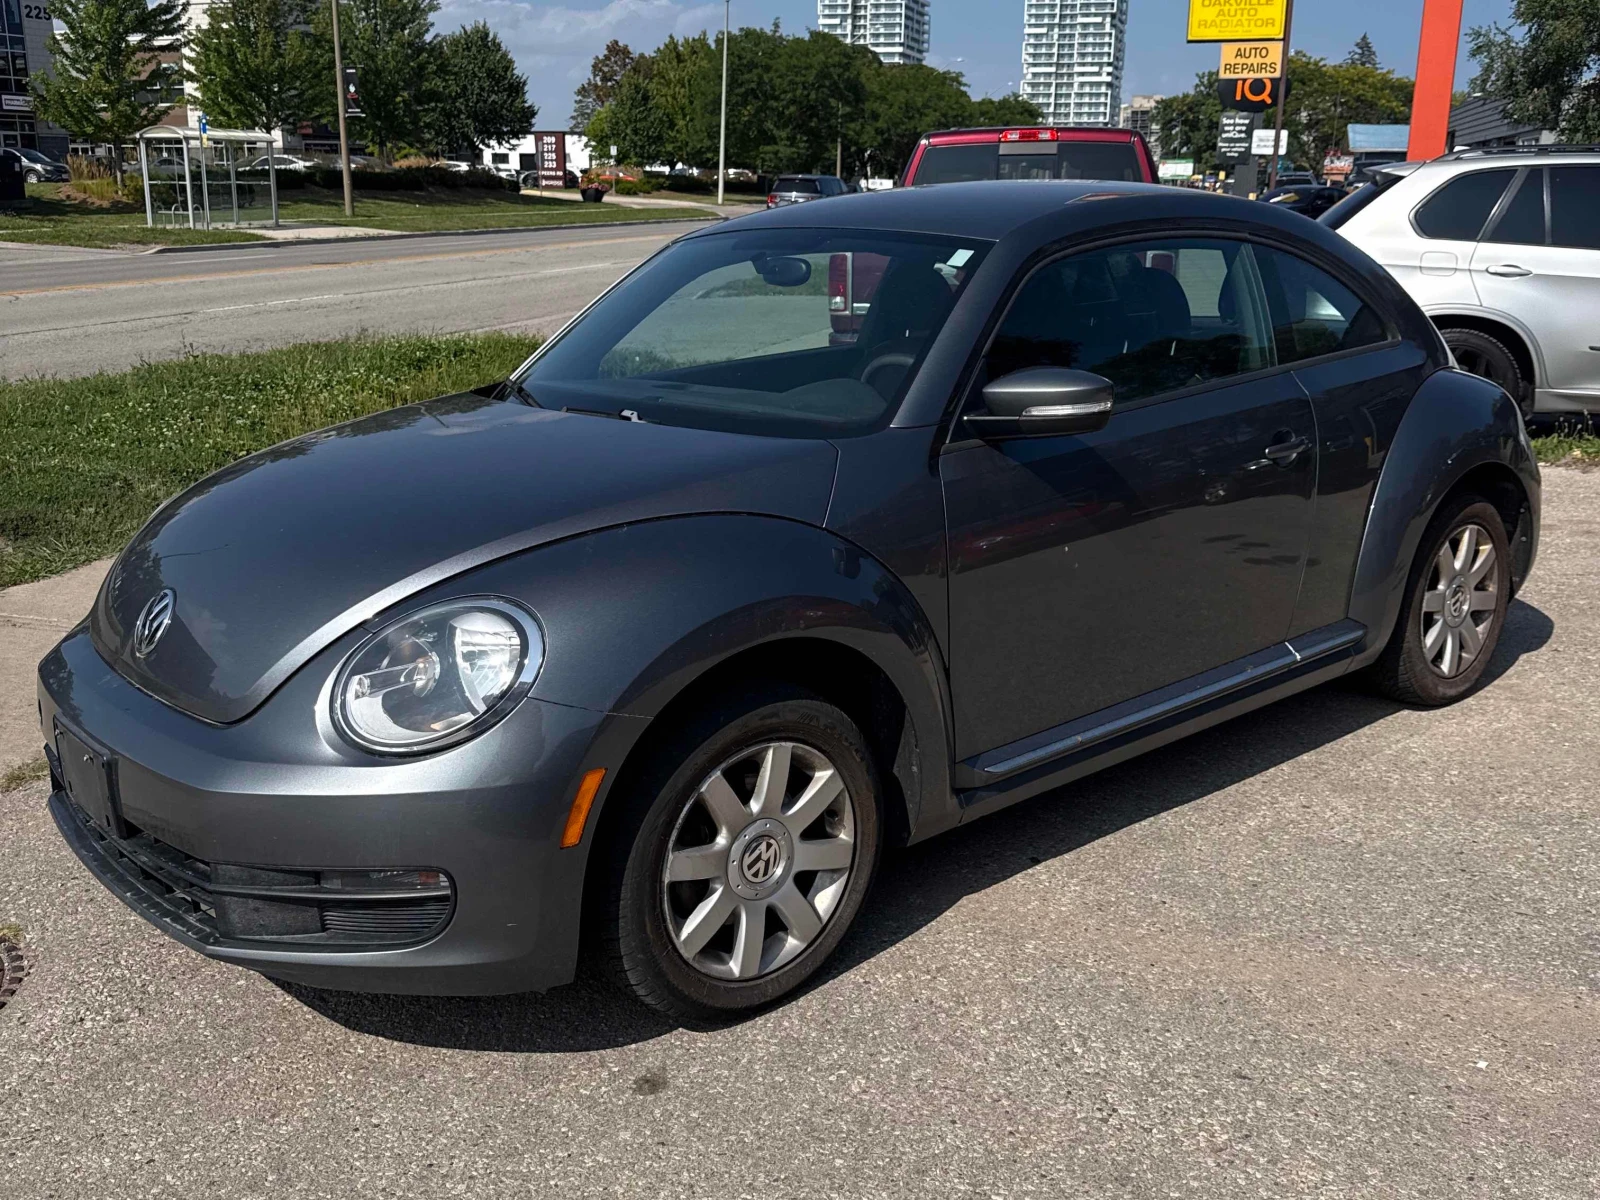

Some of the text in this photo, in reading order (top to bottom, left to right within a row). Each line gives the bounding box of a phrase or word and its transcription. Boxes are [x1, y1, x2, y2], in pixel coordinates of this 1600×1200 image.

[24, 4, 52, 20] 225
[1215, 7, 1258, 18] AUTO
[1197, 18, 1276, 29] RADIATOR
[1234, 47, 1269, 59] AUTO
[1223, 62, 1277, 75] REPAIRS
[1222, 117, 1250, 125] See how
[543, 152, 556, 160] 225
